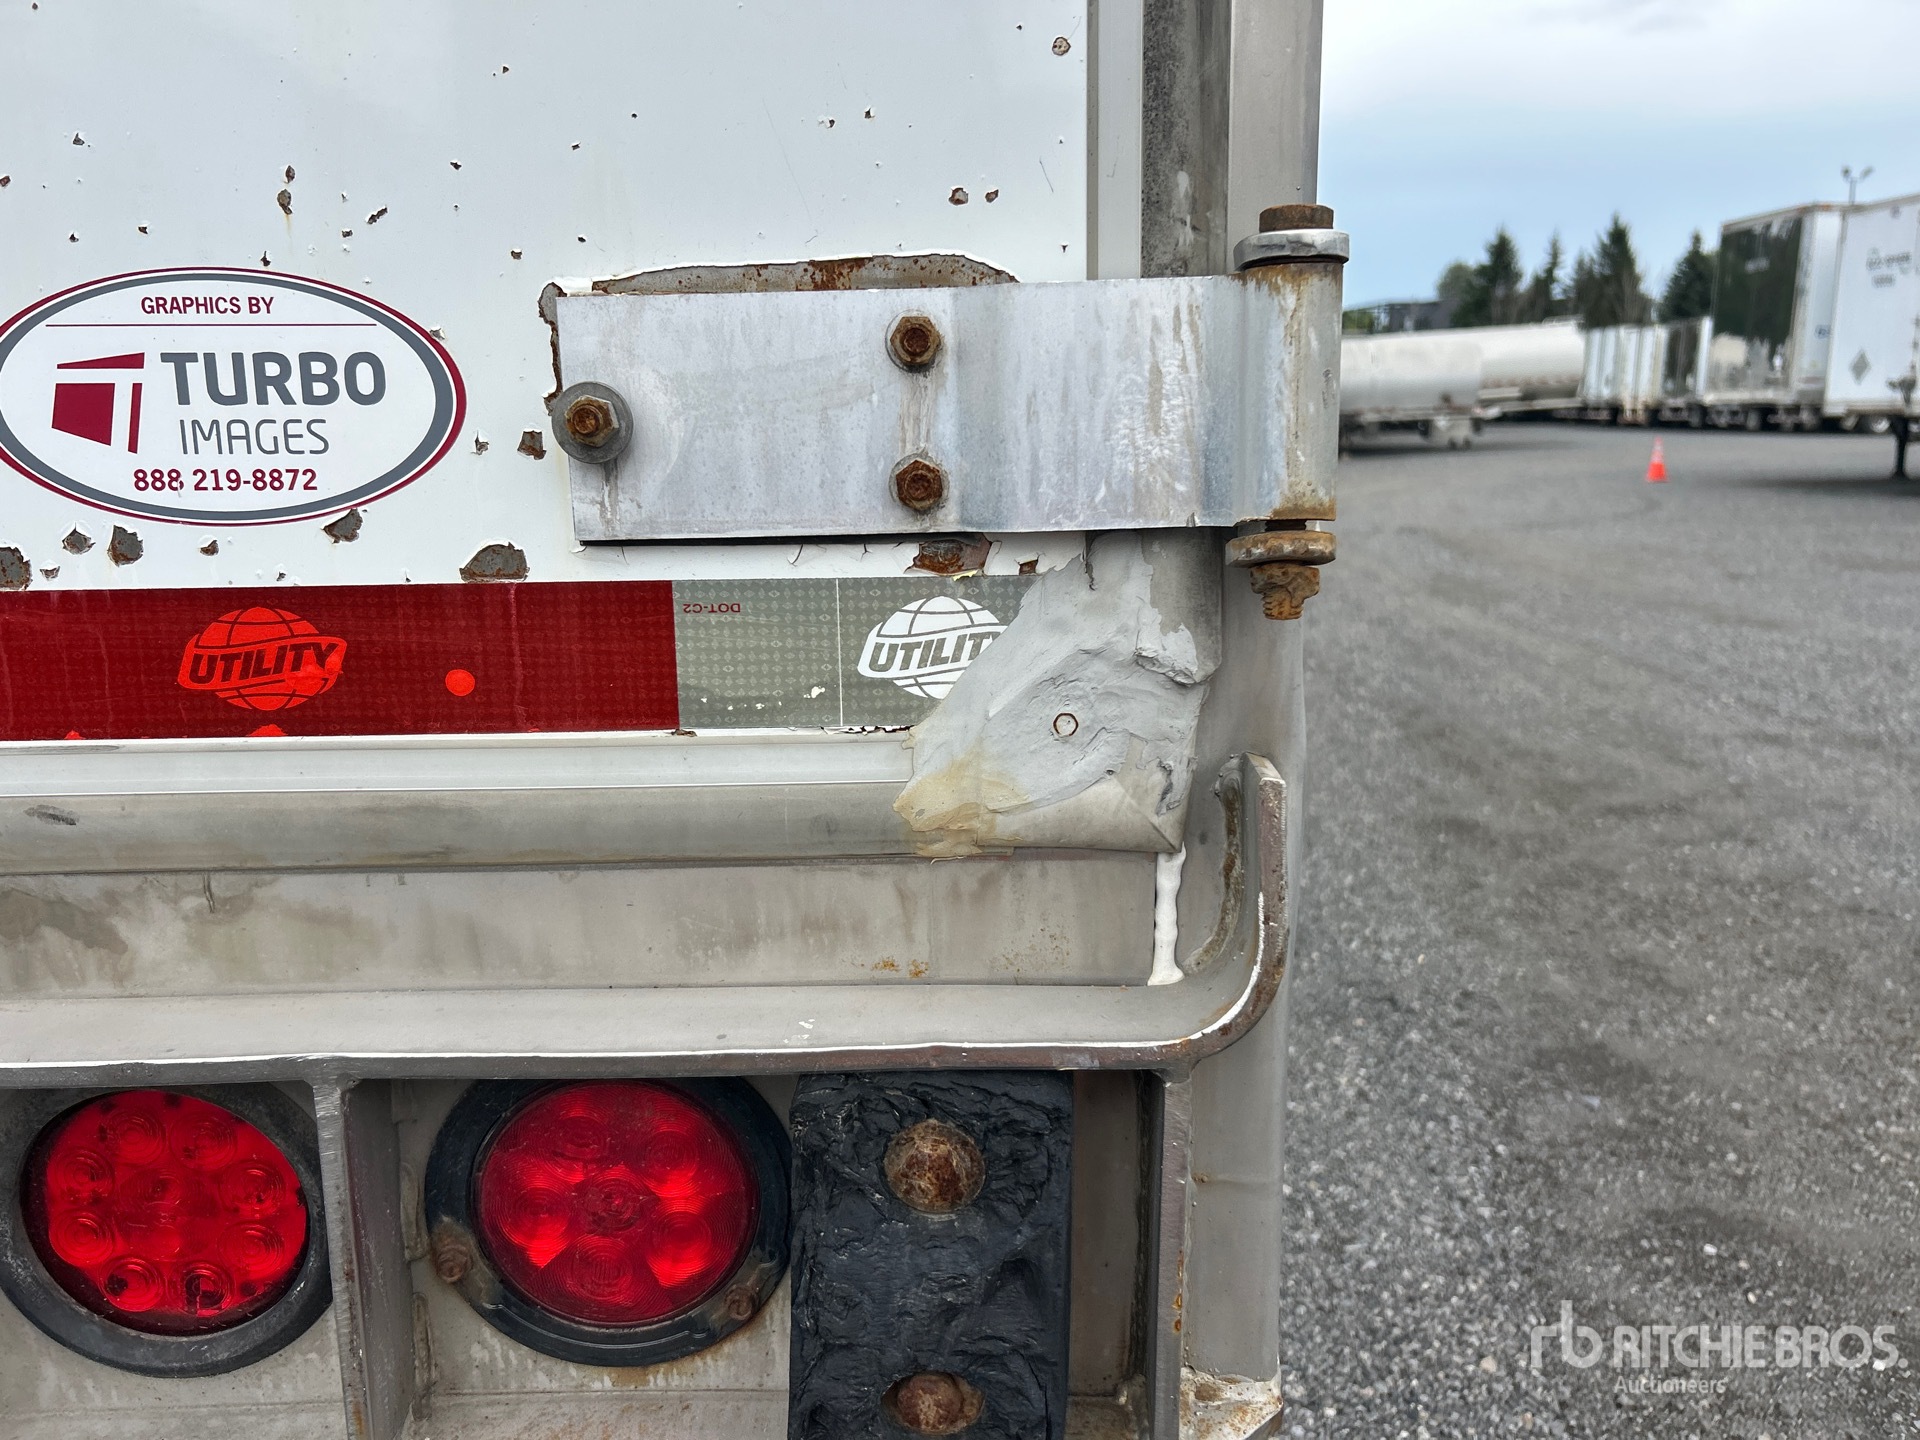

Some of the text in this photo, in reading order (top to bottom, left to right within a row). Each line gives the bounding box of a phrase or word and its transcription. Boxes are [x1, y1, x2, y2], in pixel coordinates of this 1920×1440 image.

[141, 296, 274, 314] GRAPHICS BY
[160, 352, 386, 406] TURBO
[179, 419, 329, 455] IMAGES
[133, 469, 317, 491] 888 219-8872
[683, 603, 741, 613] DOT-C2
[189, 642, 339, 684] UTILITY
[869, 631, 1001, 672] UTILIT
